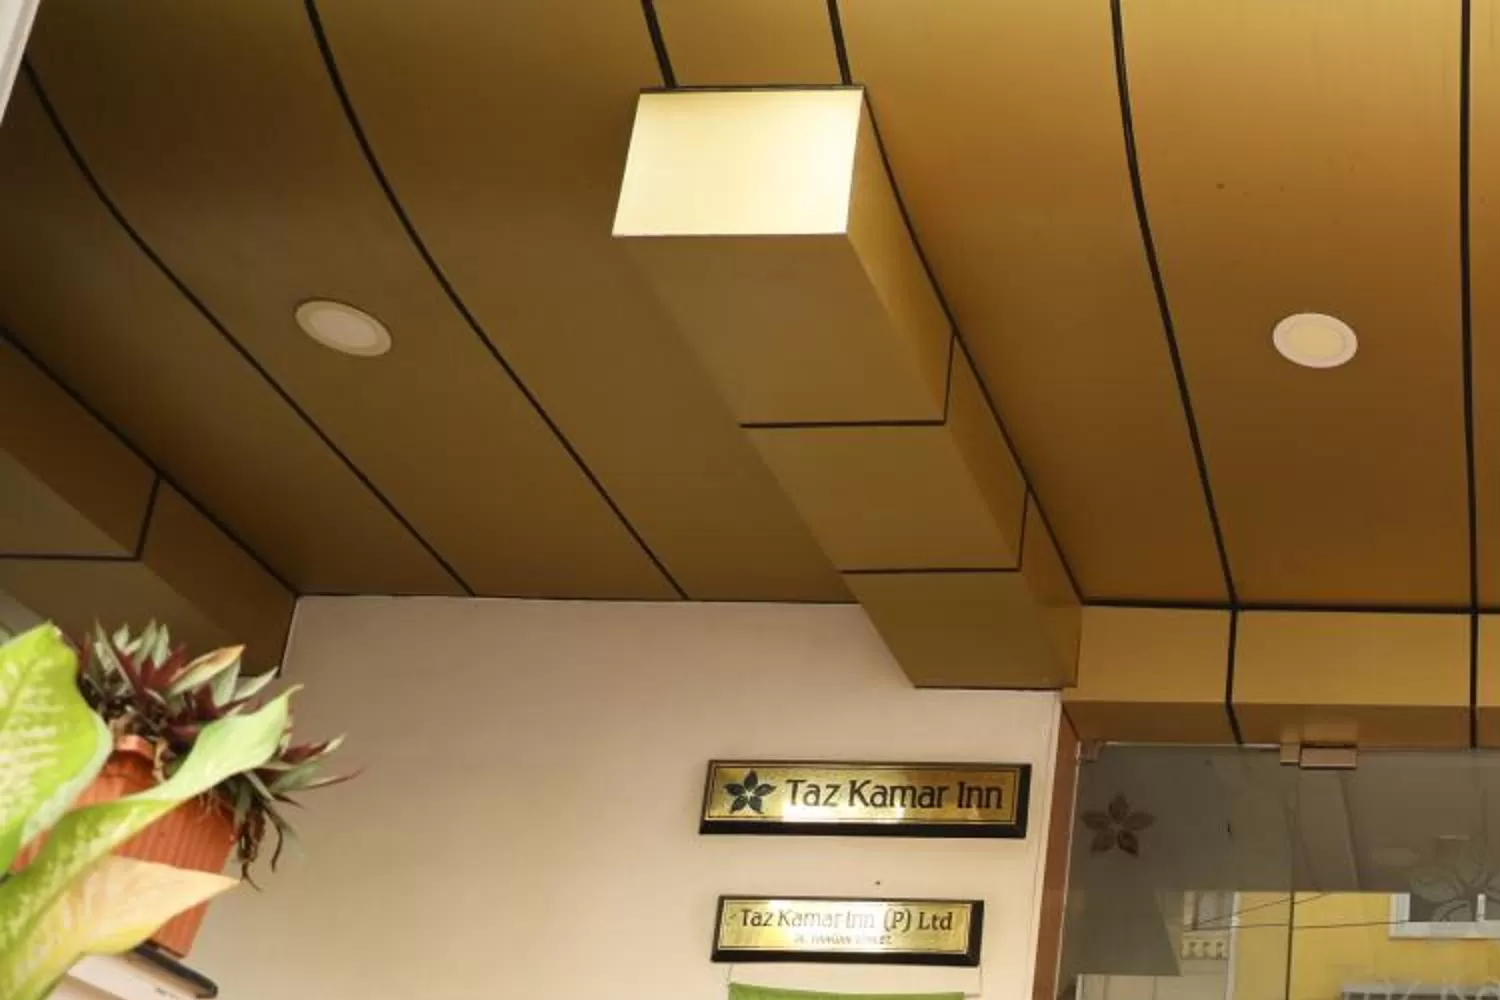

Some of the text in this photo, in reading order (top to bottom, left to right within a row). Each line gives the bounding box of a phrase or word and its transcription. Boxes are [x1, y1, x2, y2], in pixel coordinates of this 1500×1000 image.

[785, 779, 1002, 809] Taz Kamar Inn
[740, 908, 773, 927] Taz
[777, 909, 844, 929] Kamar
[883, 907, 912, 932] (P)
[917, 910, 953, 930] Ltd
